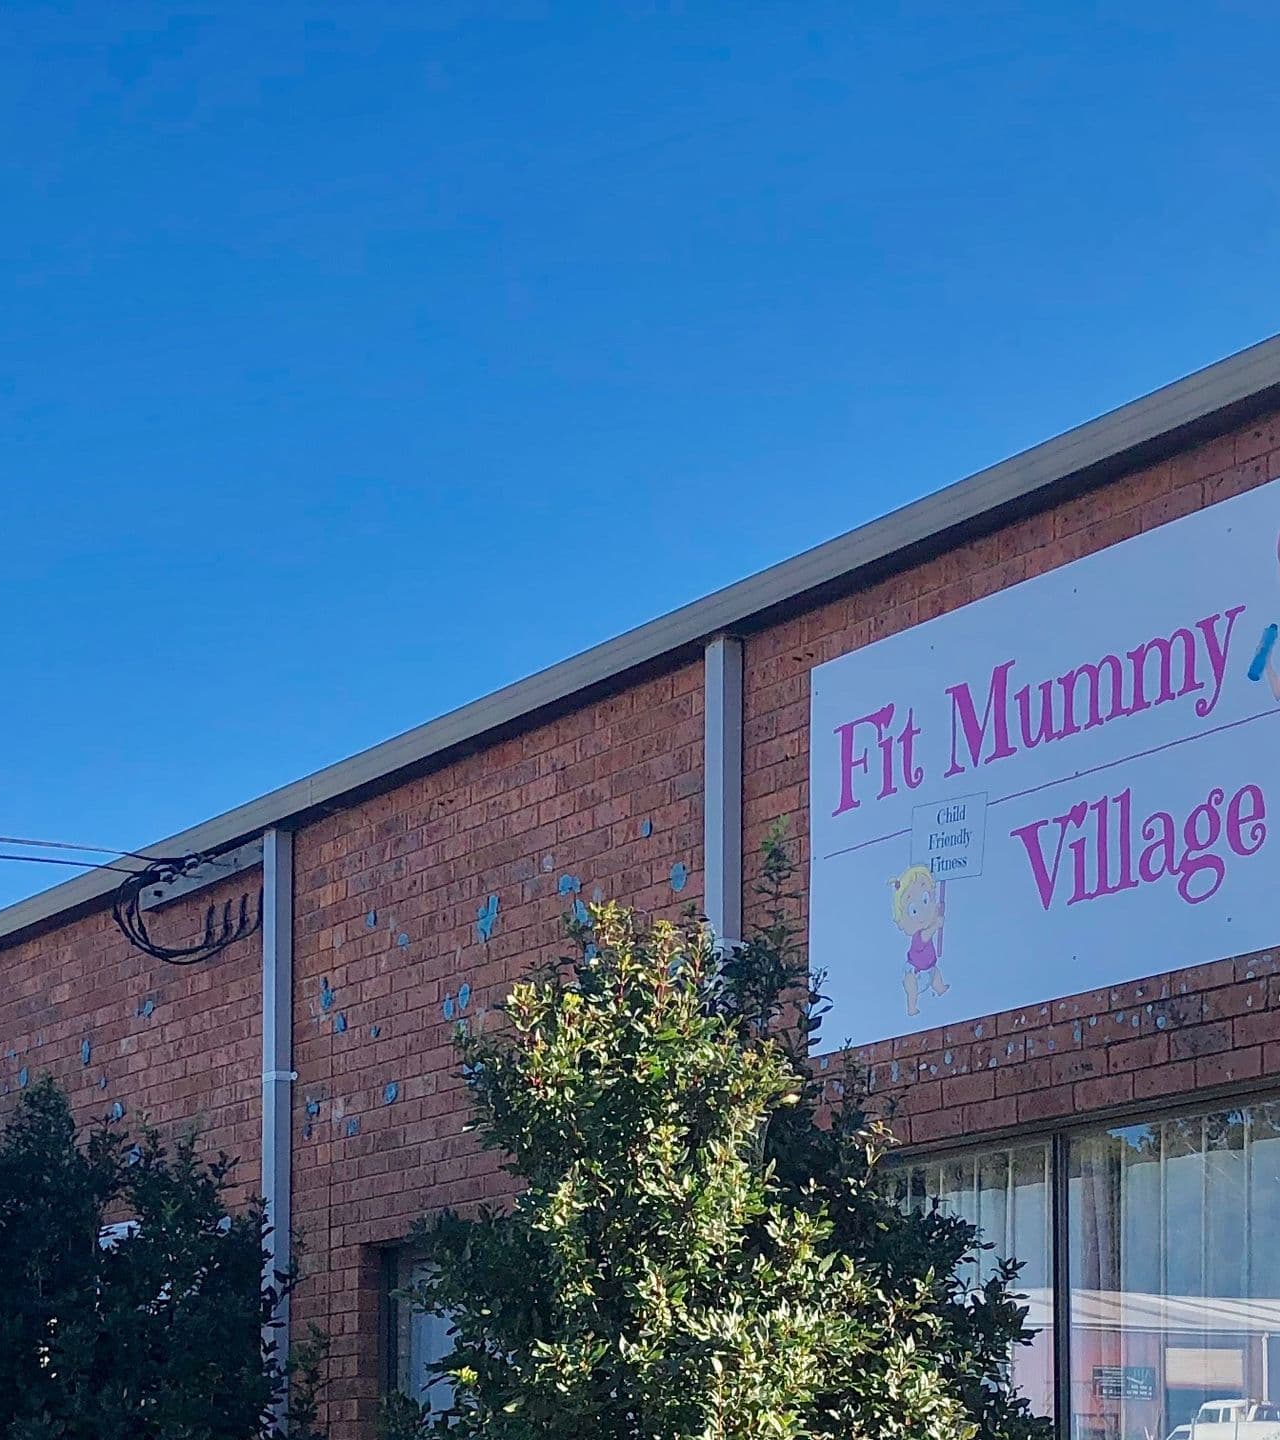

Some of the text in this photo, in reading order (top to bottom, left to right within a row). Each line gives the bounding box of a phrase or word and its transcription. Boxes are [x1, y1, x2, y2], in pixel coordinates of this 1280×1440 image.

[831, 605, 1247, 817] Fit Mummy
[937, 804, 966, 825] Child
[928, 828, 972, 850] Friendly
[1010, 784, 1267, 911] Village
[930, 856, 968, 873] Fitness
